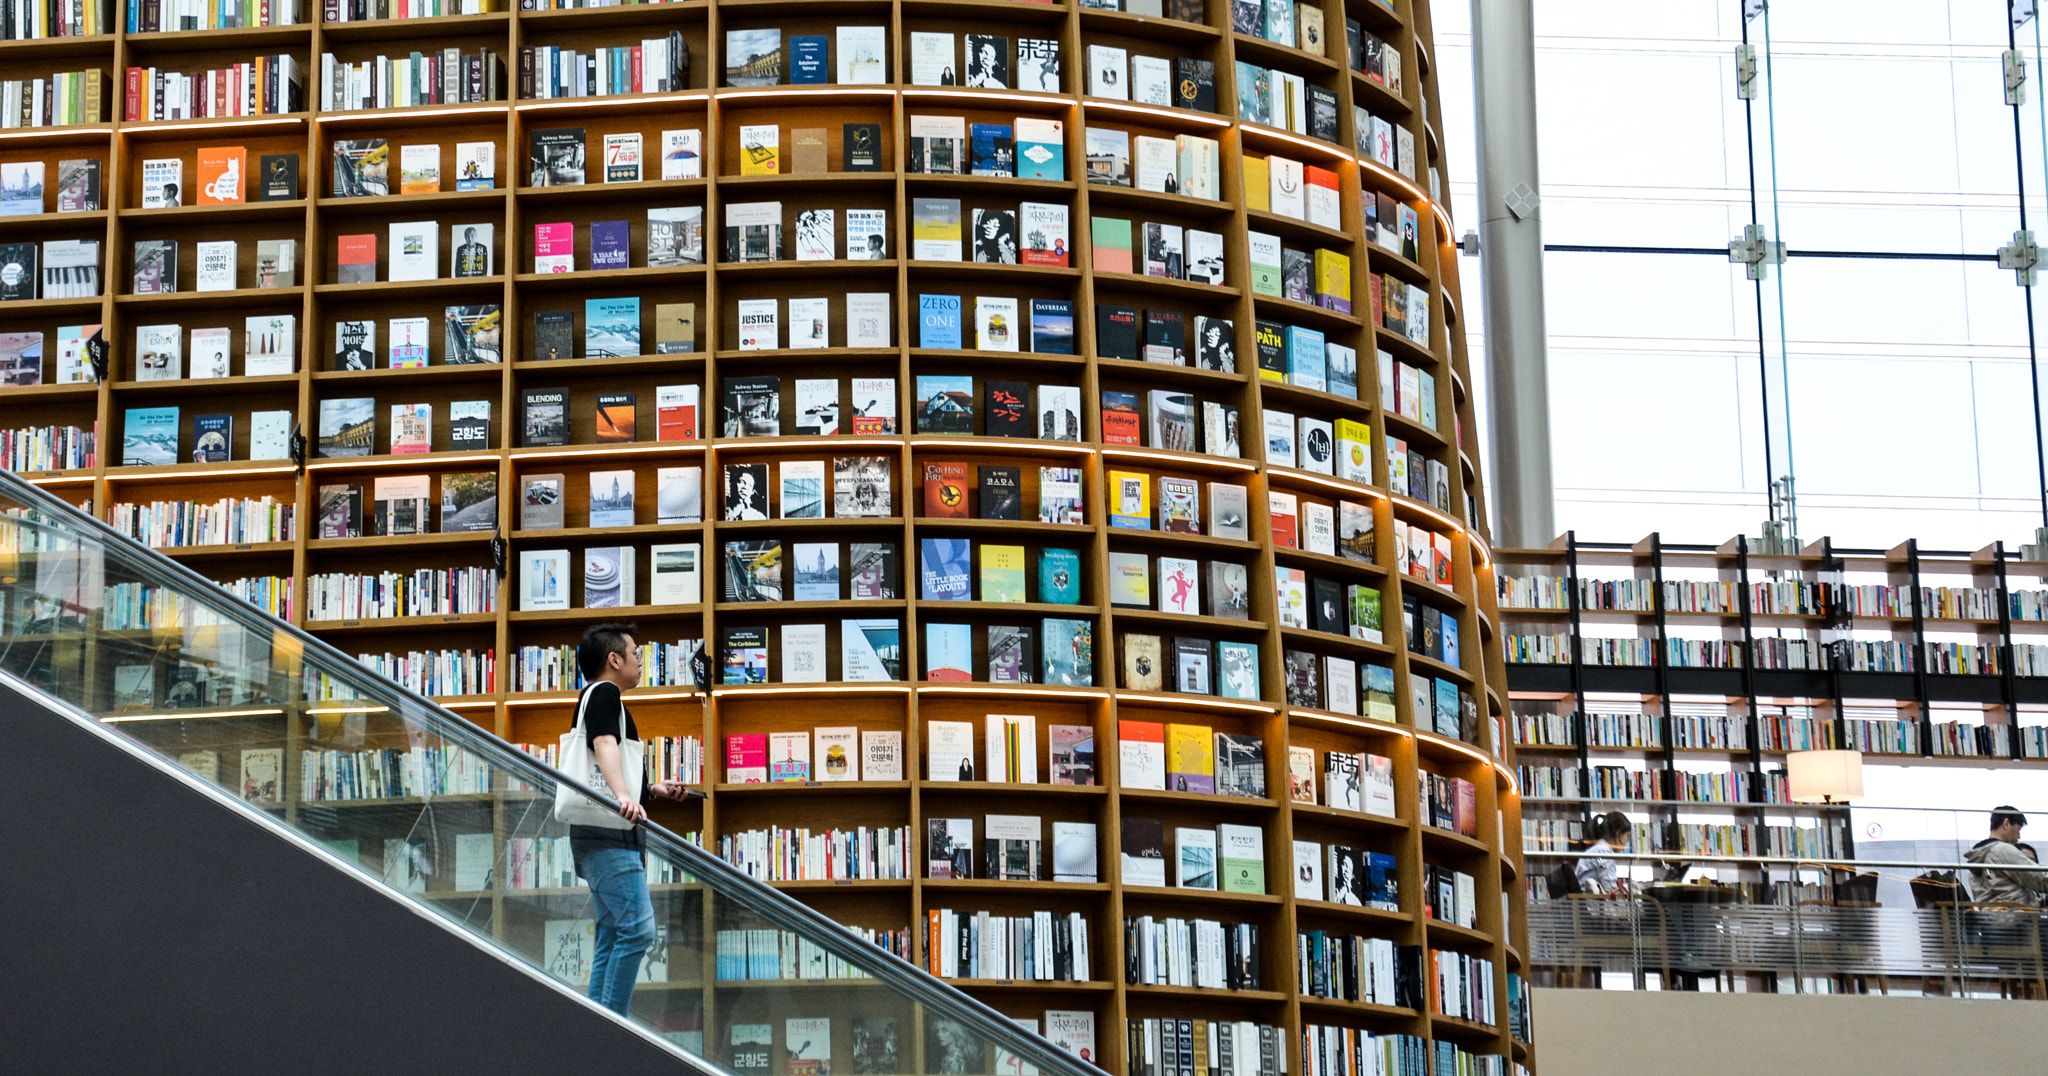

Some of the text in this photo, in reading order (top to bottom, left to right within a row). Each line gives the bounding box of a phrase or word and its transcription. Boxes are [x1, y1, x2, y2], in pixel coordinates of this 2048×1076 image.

[650, 223, 700, 237] HOUSE
[650, 237, 700, 250] STYLE
[922, 297, 959, 310] ZERO
[1035, 304, 1068, 312] DAYBREAK
[742, 314, 775, 324] JUSTICE
[925, 314, 956, 328] ONE
[1256, 331, 1282, 347] PATH
[527, 394, 563, 403] BLENDING
[452, 427, 485, 440] 군함도
[1308, 431, 1331, 461] 시밤
[986, 478, 1014, 487] 코스모스
[925, 574, 969, 586] LITTLE BOOK
[932, 582, 967, 593] LAYOUTS
[870, 745, 894, 754] 이야기
[870, 754, 894, 763] 인문학
[734, 1053, 768, 1068] 군함도
